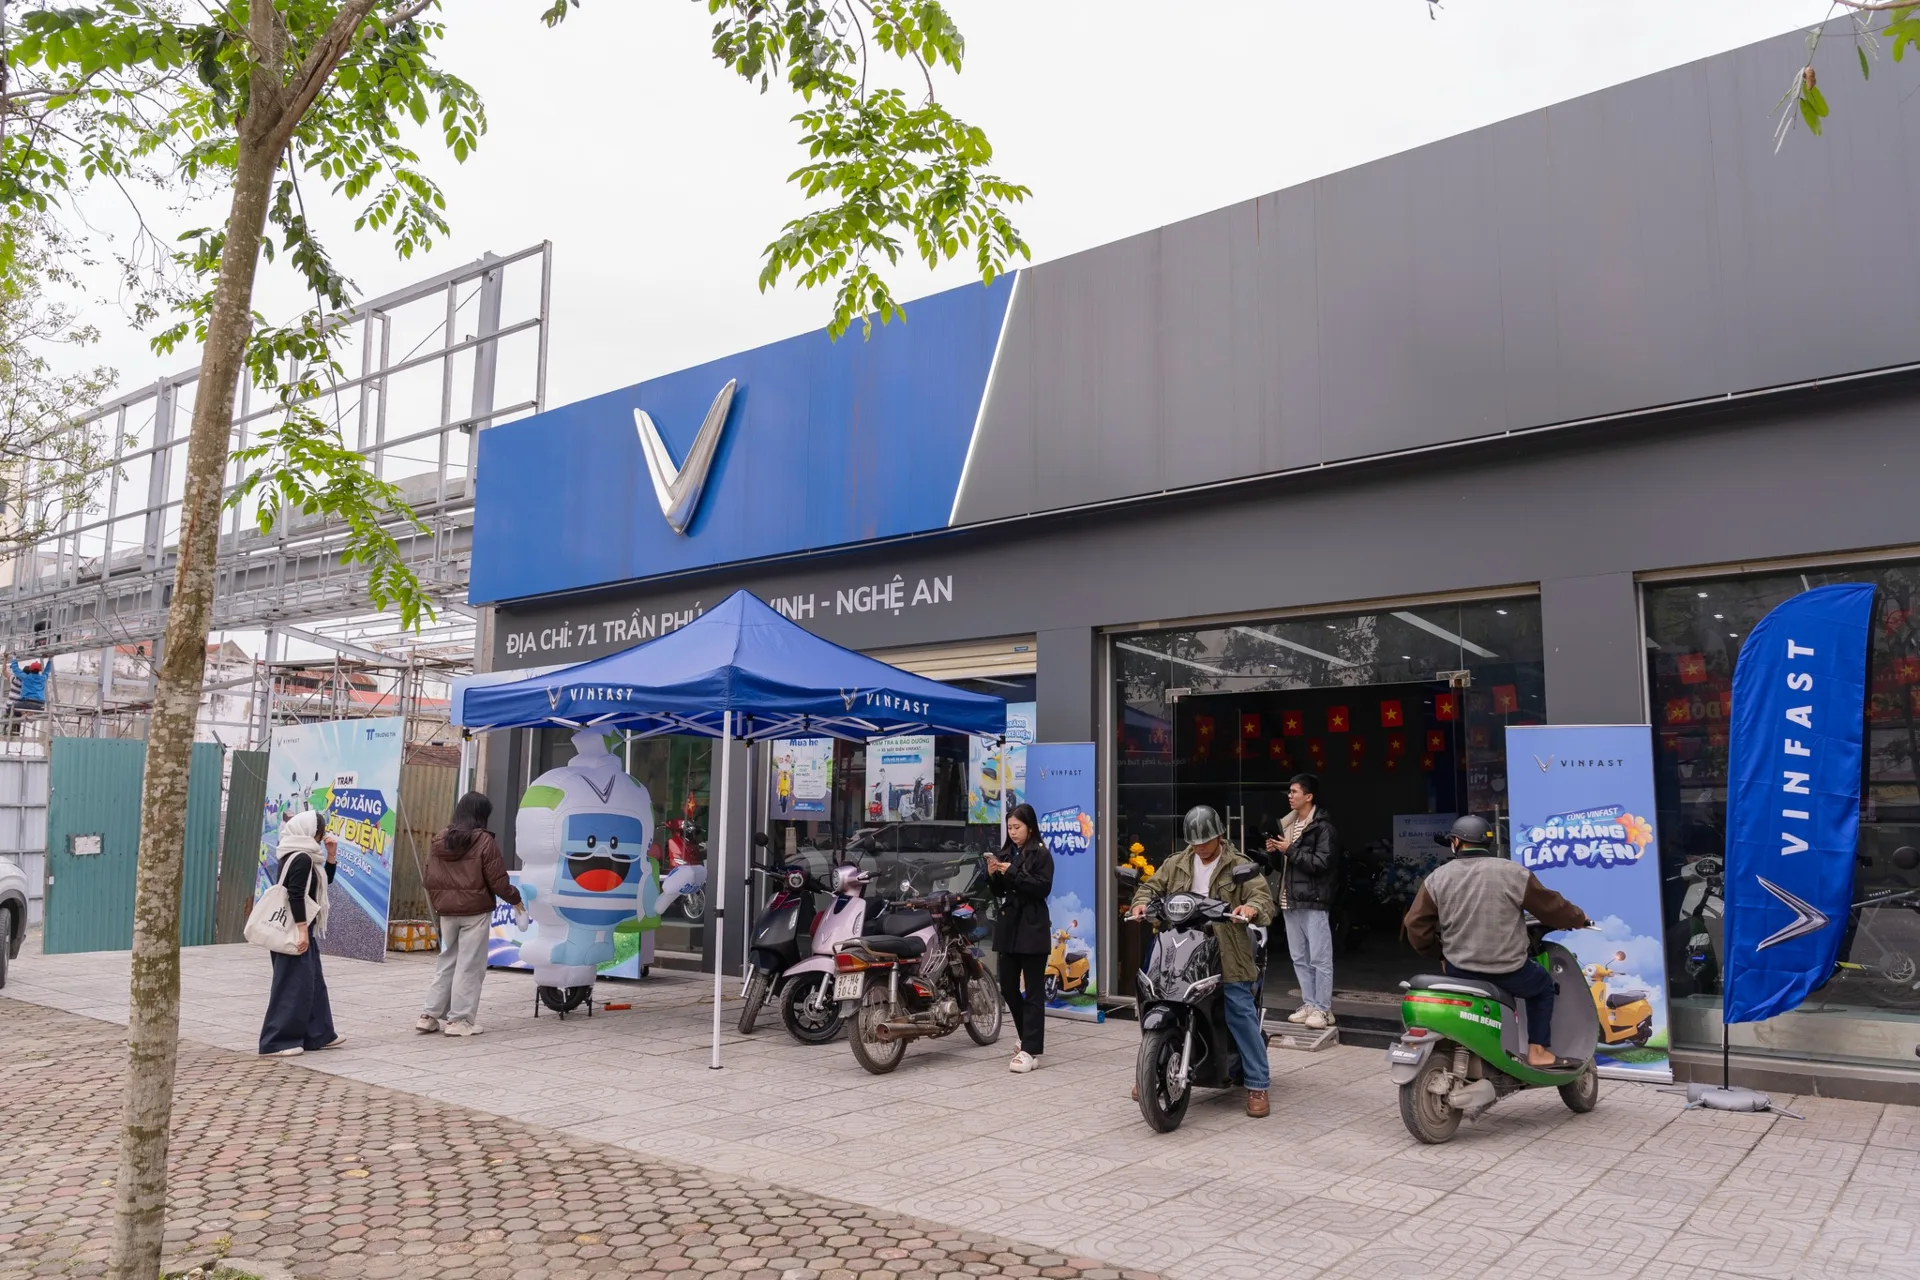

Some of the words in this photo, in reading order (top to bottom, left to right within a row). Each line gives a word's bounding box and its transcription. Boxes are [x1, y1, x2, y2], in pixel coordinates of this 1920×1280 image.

[506, 632, 537, 658] ĐỊA
[540, 621, 573, 650] CHỈ:
[577, 623, 598, 647] 71
[602, 608, 656, 643] TRẦN
[769, 593, 815, 620] INH
[836, 574, 905, 616] NGHỆ
[911, 575, 953, 606] AN
[570, 687, 634, 701] VINFAST
[866, 693, 930, 716] VINFAST
[1781, 638, 1815, 856] VINFAST
[1561, 759, 1624, 767] VINFAST
[337, 775, 354, 787] TRẠM
[350, 795, 382, 816] XĂNG
[1566, 811, 1586, 822] CÙNG
[1586, 806, 1619, 819] VINFAST
[1052, 817, 1081, 833] XĂNG
[1531, 817, 1565, 843] ĐỔI
[1566, 819, 1626, 840] XĂNG
[345, 818, 386, 856] ĐIỆN
[1523, 839, 1570, 868] LẤY
[1573, 839, 1636, 864] ĐIỆN
[1460, 1010, 1479, 1022] MOM
[1480, 1015, 1502, 1029] BEAUTY
